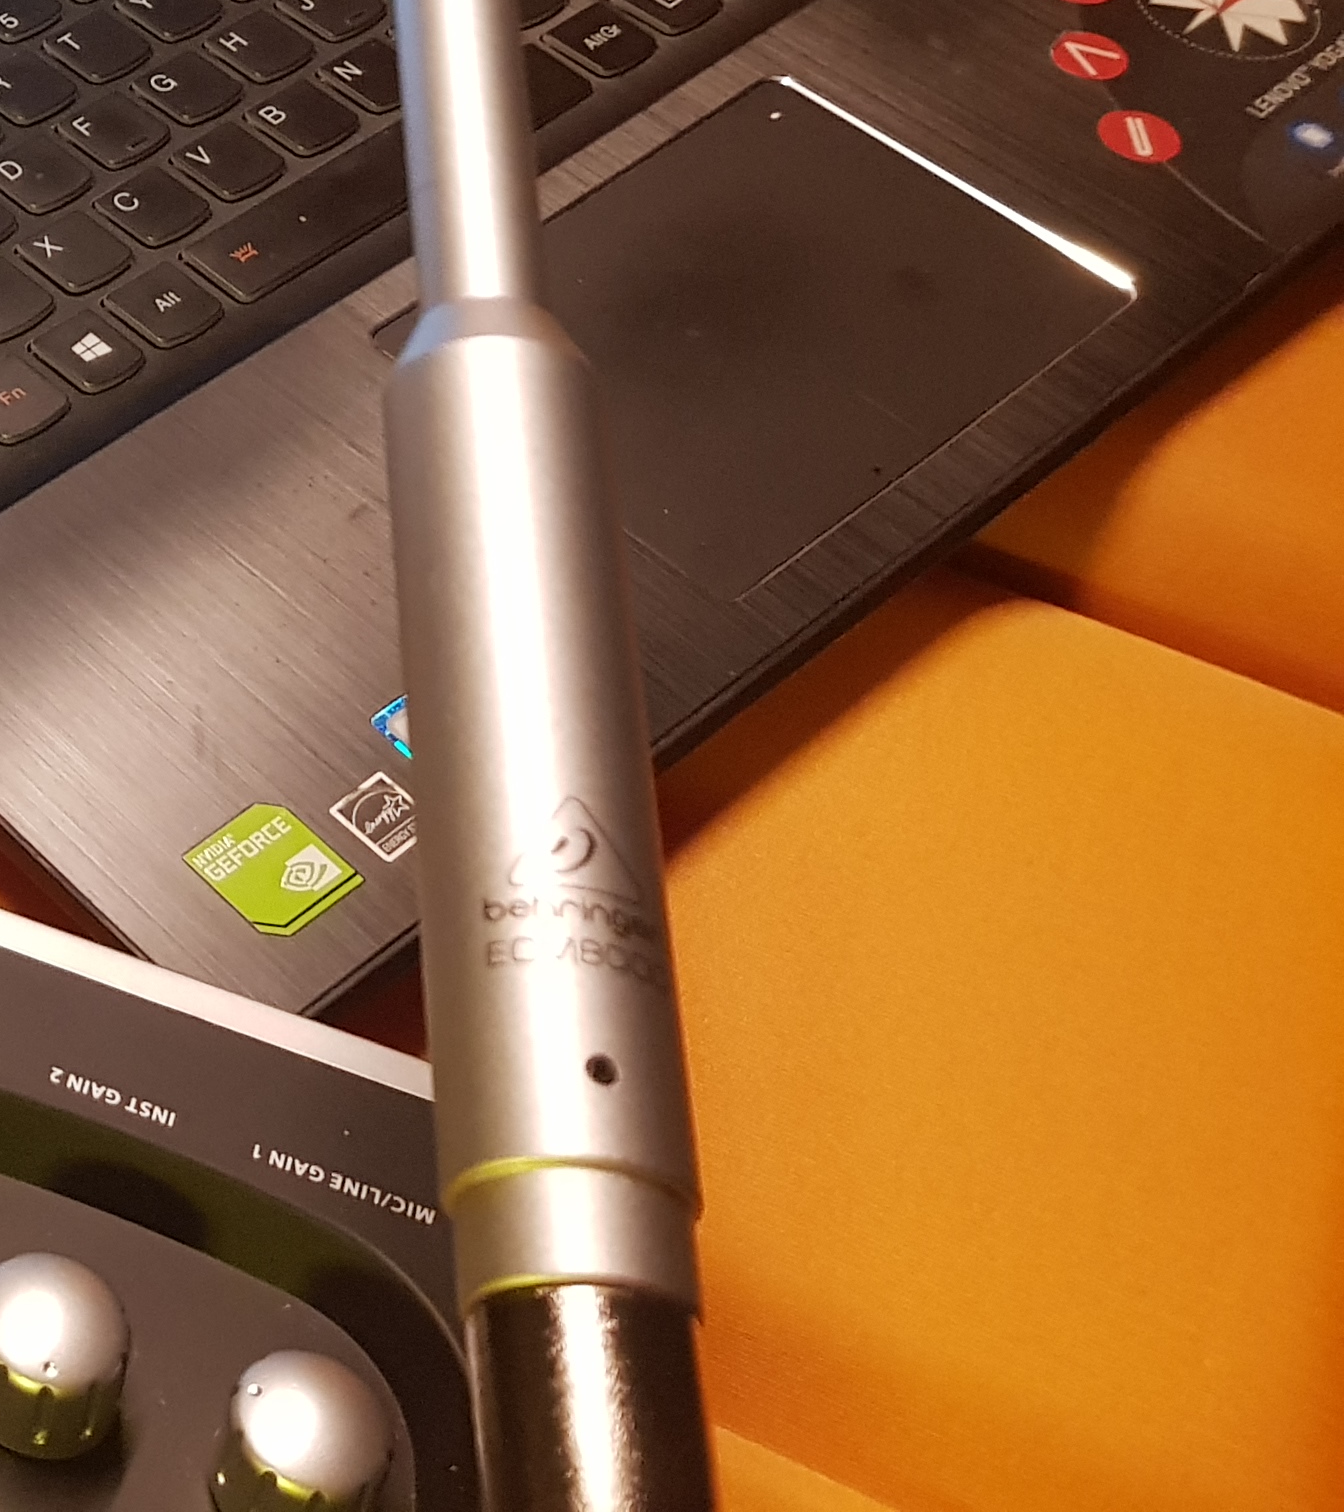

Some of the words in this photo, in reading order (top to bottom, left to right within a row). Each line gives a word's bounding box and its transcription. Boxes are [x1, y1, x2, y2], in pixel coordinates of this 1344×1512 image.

[583, 24, 622, 51] AltGr
[33, 235, 64, 258] X
[154, 291, 182, 312] Alt
[192, 833, 234, 869] NVIDIA
[204, 816, 292, 882] GEFORCE
[49, 1066, 63, 1083] 2
[66, 1073, 122, 1105] GAIN
[125, 1097, 177, 1128] INST
[252, 1143, 263, 1160] 1
[268, 1150, 325, 1183] GAIN
[330, 1171, 436, 1225] MIC/LINE
